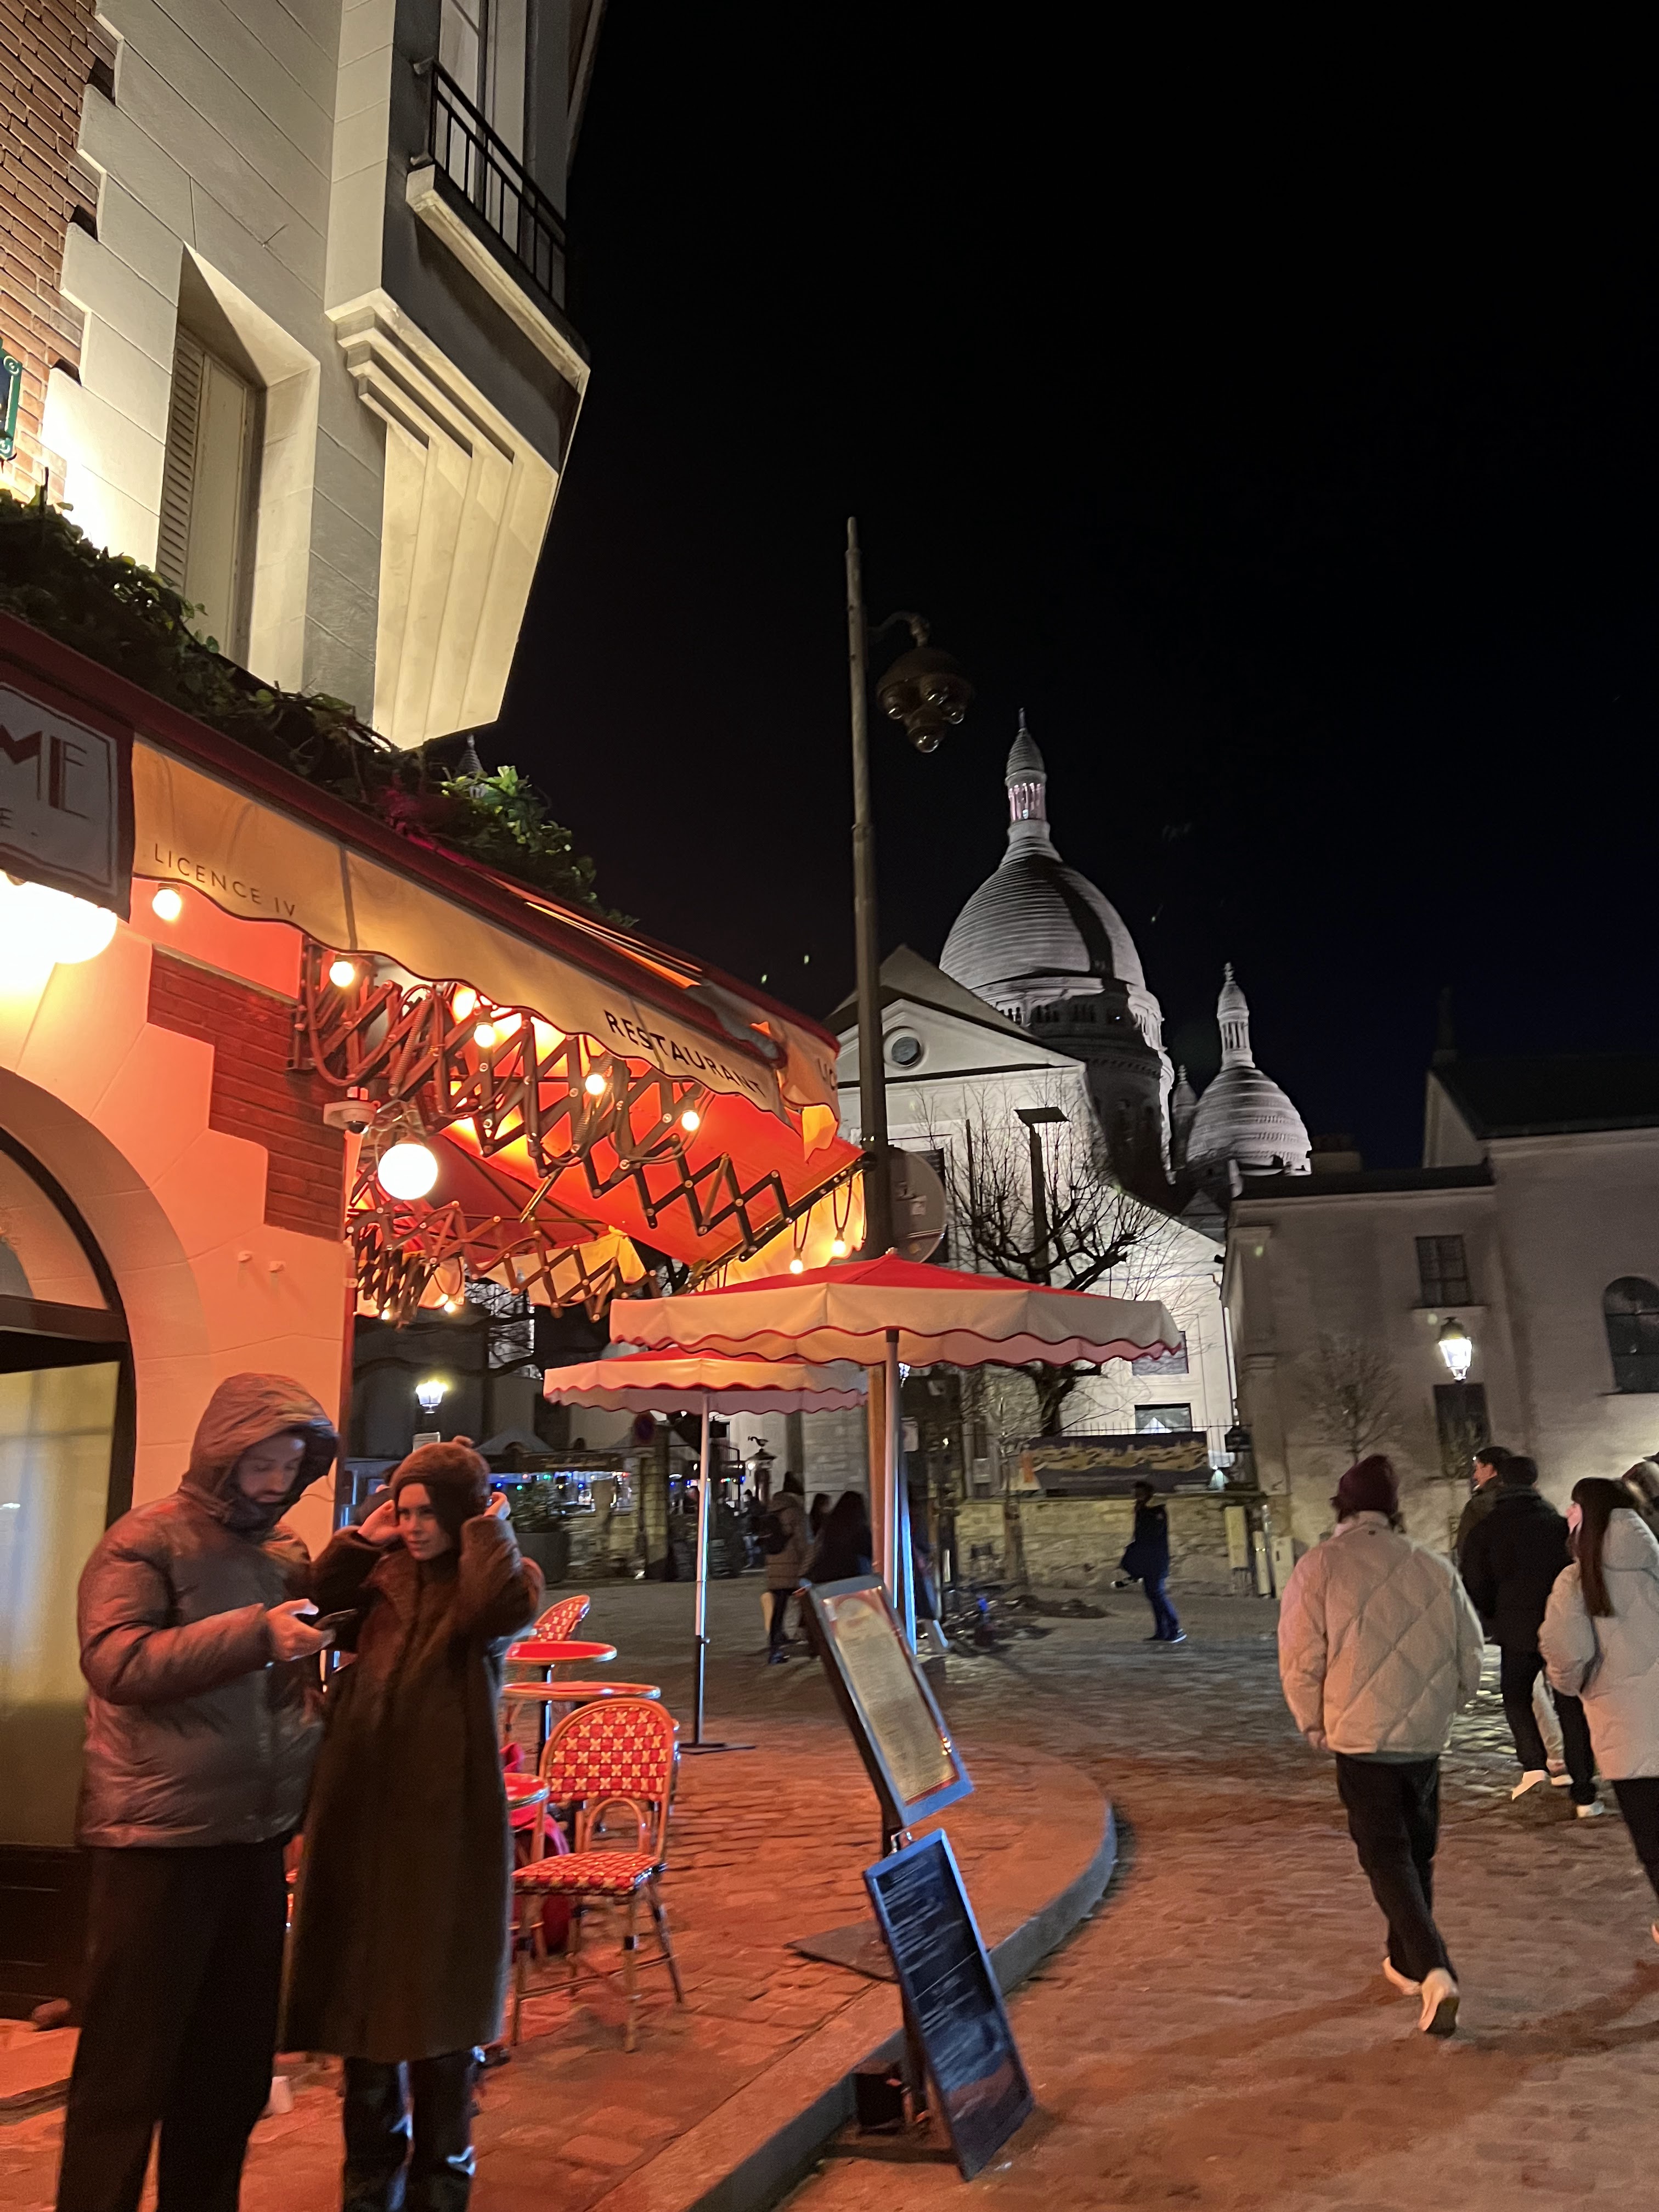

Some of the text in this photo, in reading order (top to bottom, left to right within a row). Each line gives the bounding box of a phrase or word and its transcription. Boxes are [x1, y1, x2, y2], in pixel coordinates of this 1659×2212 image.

[154, 843, 296, 917] LICENCE IV
[604, 1010, 766, 1096] RESTAURANT
